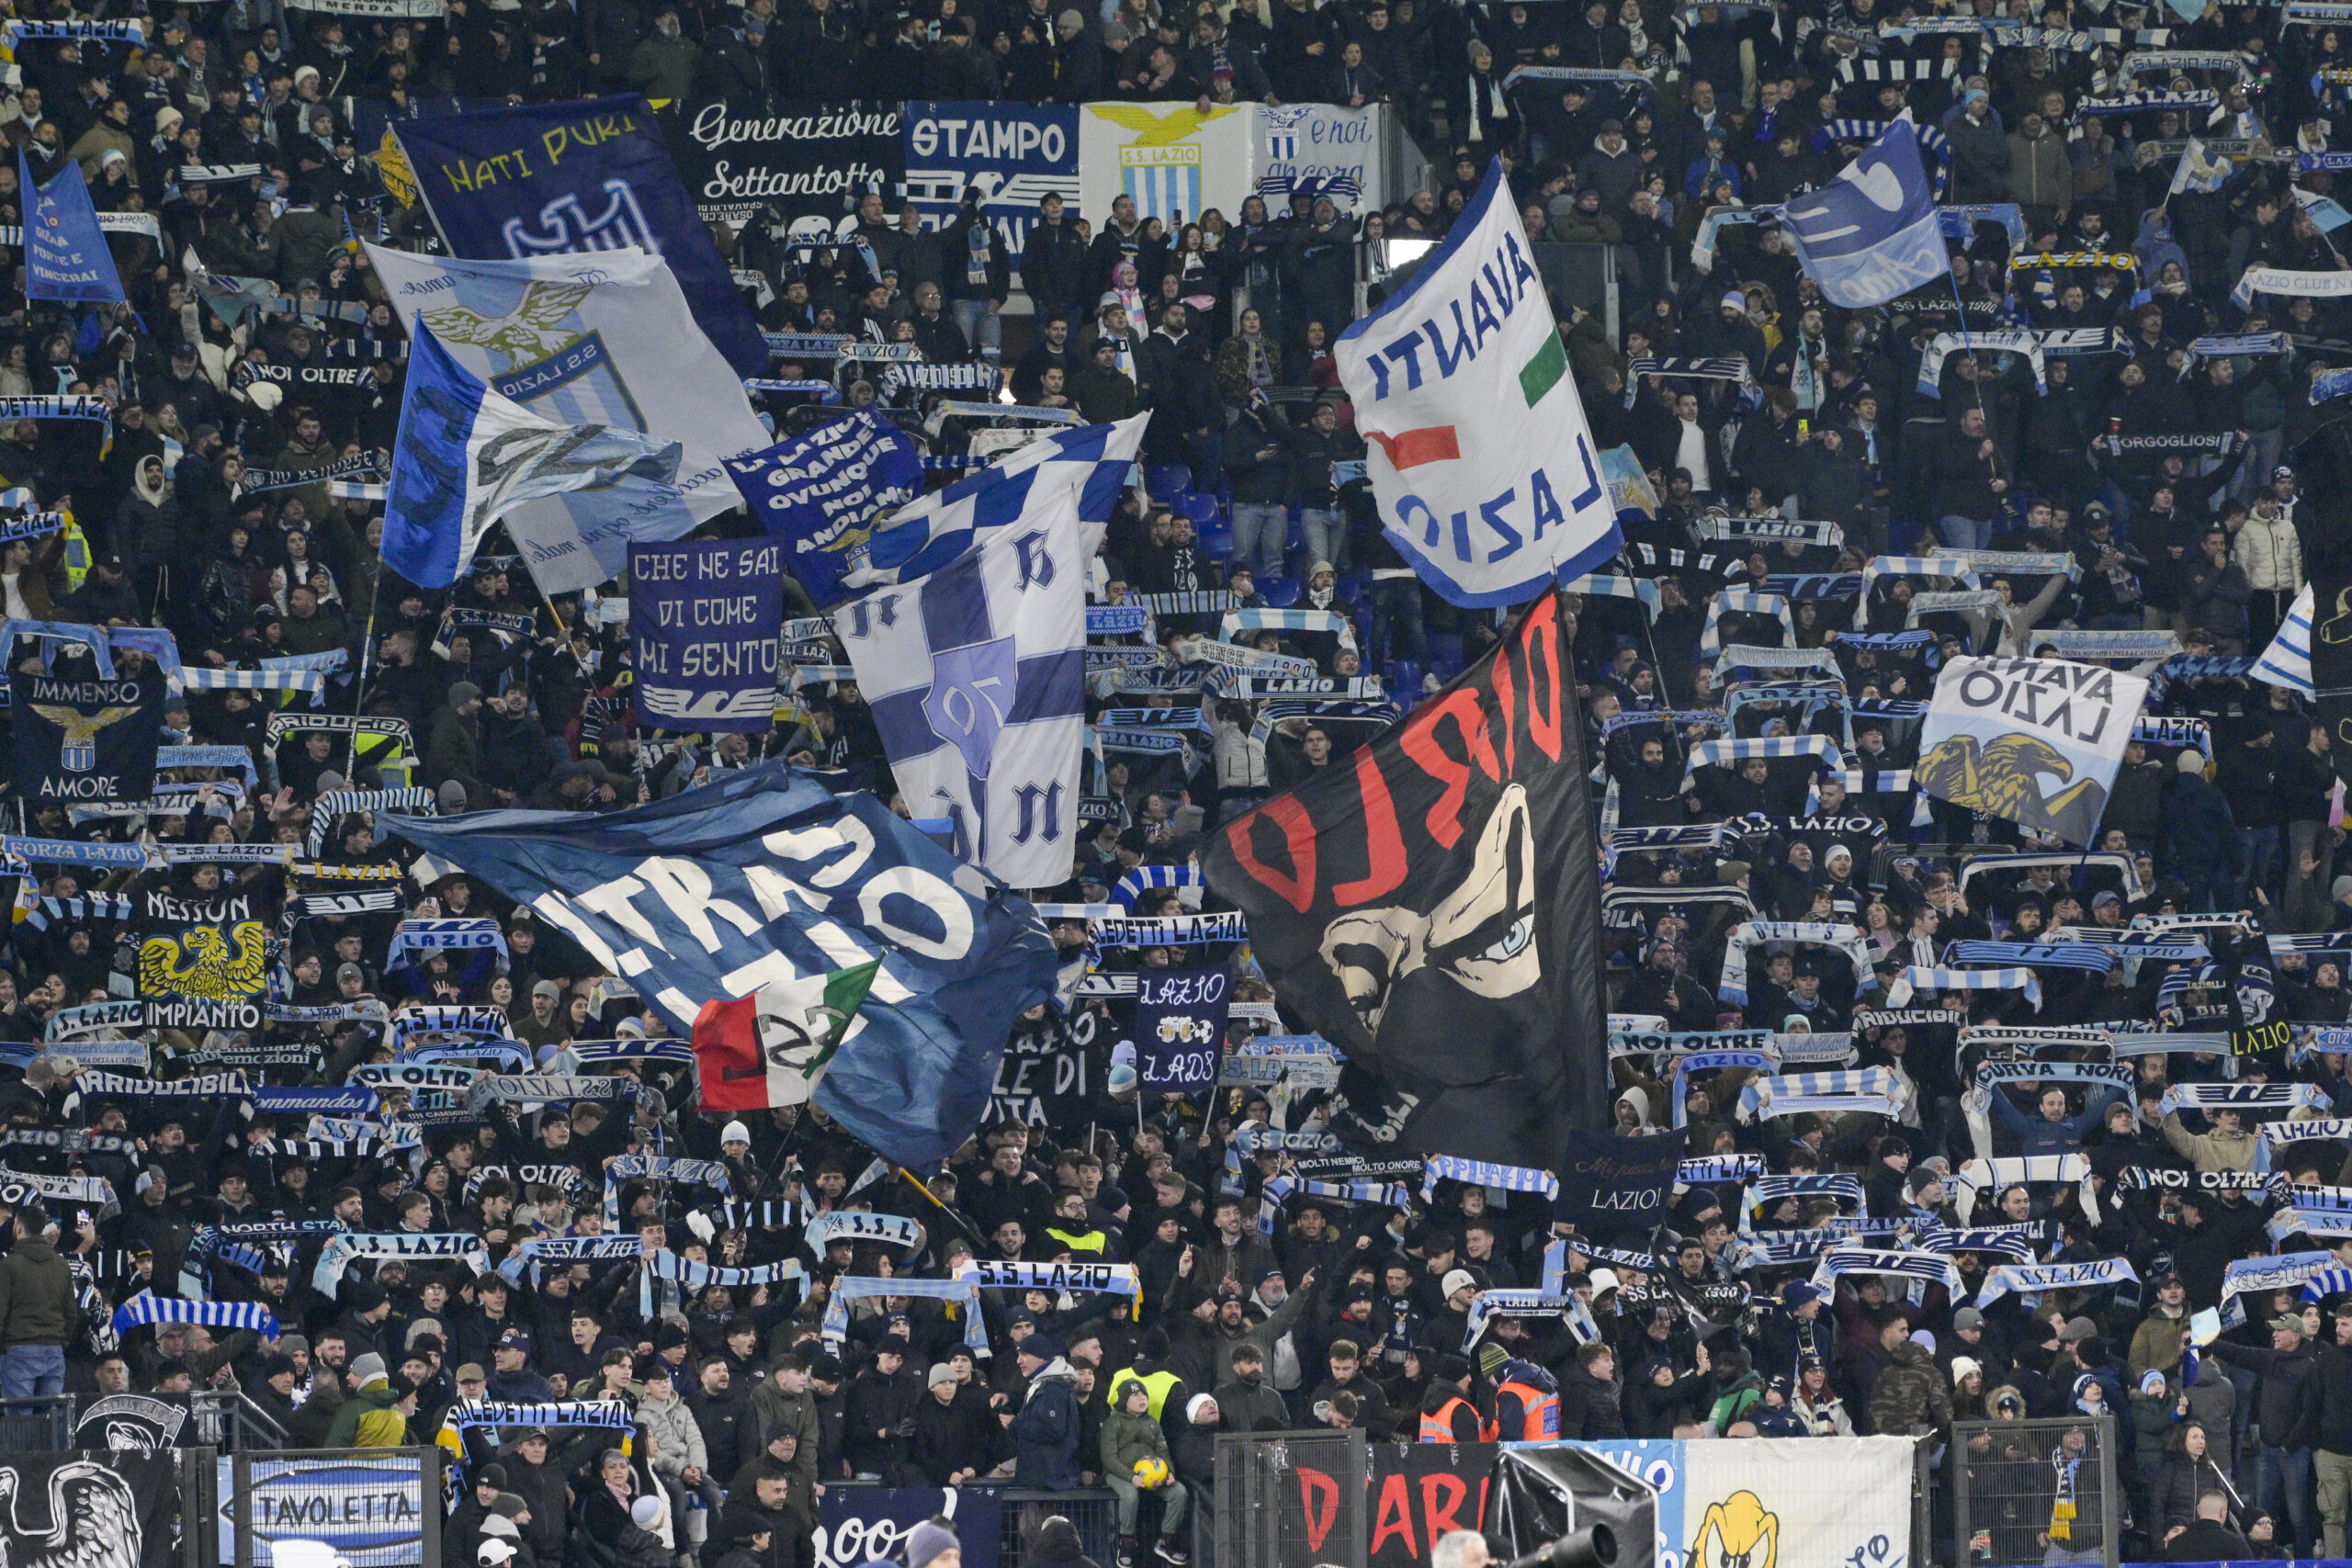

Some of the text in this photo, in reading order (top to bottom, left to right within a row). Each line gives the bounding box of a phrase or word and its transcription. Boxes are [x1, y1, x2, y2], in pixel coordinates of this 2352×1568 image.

[689, 103, 900, 151] Generazione
[1311, 116, 1373, 143] e noi
[911, 118, 1066, 164] STAMPO
[1124, 148, 1196, 164] S.S. LAZIO
[442, 149, 533, 193] NATI
[704, 160, 886, 199] Settantotto
[2010, 250, 2135, 270] LAZIO
[2293, 275, 2331, 289] CLUB
[300, 367, 359, 385] OLTRE
[768, 425, 875, 487] GRANDE
[769, 436, 899, 510] OVUNQUE
[821, 483, 873, 518] NOI
[796, 483, 914, 554] ANDIAMO
[1742, 524, 1805, 536] LAZIO
[635, 547, 779, 581] CHE NE SAI
[660, 595, 757, 627] DI COME
[2097, 631, 2162, 648] LAZIO
[639, 637, 779, 677] MI SENTO
[1200, 641, 1245, 666] SINCE
[33, 679, 140, 704] IMMENSO
[1265, 679, 1334, 693] LAZIO
[1739, 688, 1842, 701] LAZIO
[40, 775, 119, 798] AMORE
[1789, 817, 1872, 833] LAZIO
[11, 842, 140, 862] FORZA LAZIO
[218, 845, 275, 855] LAZIO
[148, 890, 250, 923] NESSUN
[403, 933, 494, 947] LAZIO
[2121, 946, 2184, 958] LAZIO
[1140, 973, 1226, 1007] LAZIO
[79, 1002, 142, 1026] LAZIO
[148, 1001, 260, 1029] IMPIANTO
[1623, 1032, 1766, 1051] NOI OLTRE
[2233, 1021, 2290, 1056] LAZIO
[1055, 1050, 1087, 1098] DI
[1142, 1051, 1215, 1084] LADS
[1978, 1062, 2055, 1085] CURVA
[1250, 1133, 1272, 1150] SS
[1297, 1156, 1365, 1169] MOLTI NEMICI
[1351, 1163, 1384, 1173] MOLTO
[1385, 1160, 1421, 1171] ONORE
[1478, 1161, 1537, 1183] LAZIO
[519, 1165, 578, 1190] OLTRE
[2150, 1170, 2268, 1190] NOI OLTRE
[1591, 1188, 1660, 1210] LAZIO!
[220, 1222, 296, 1235] NORTH
[396, 1235, 481, 1255] LAZIO
[263, 1490, 419, 1529] TAVOLETTA
